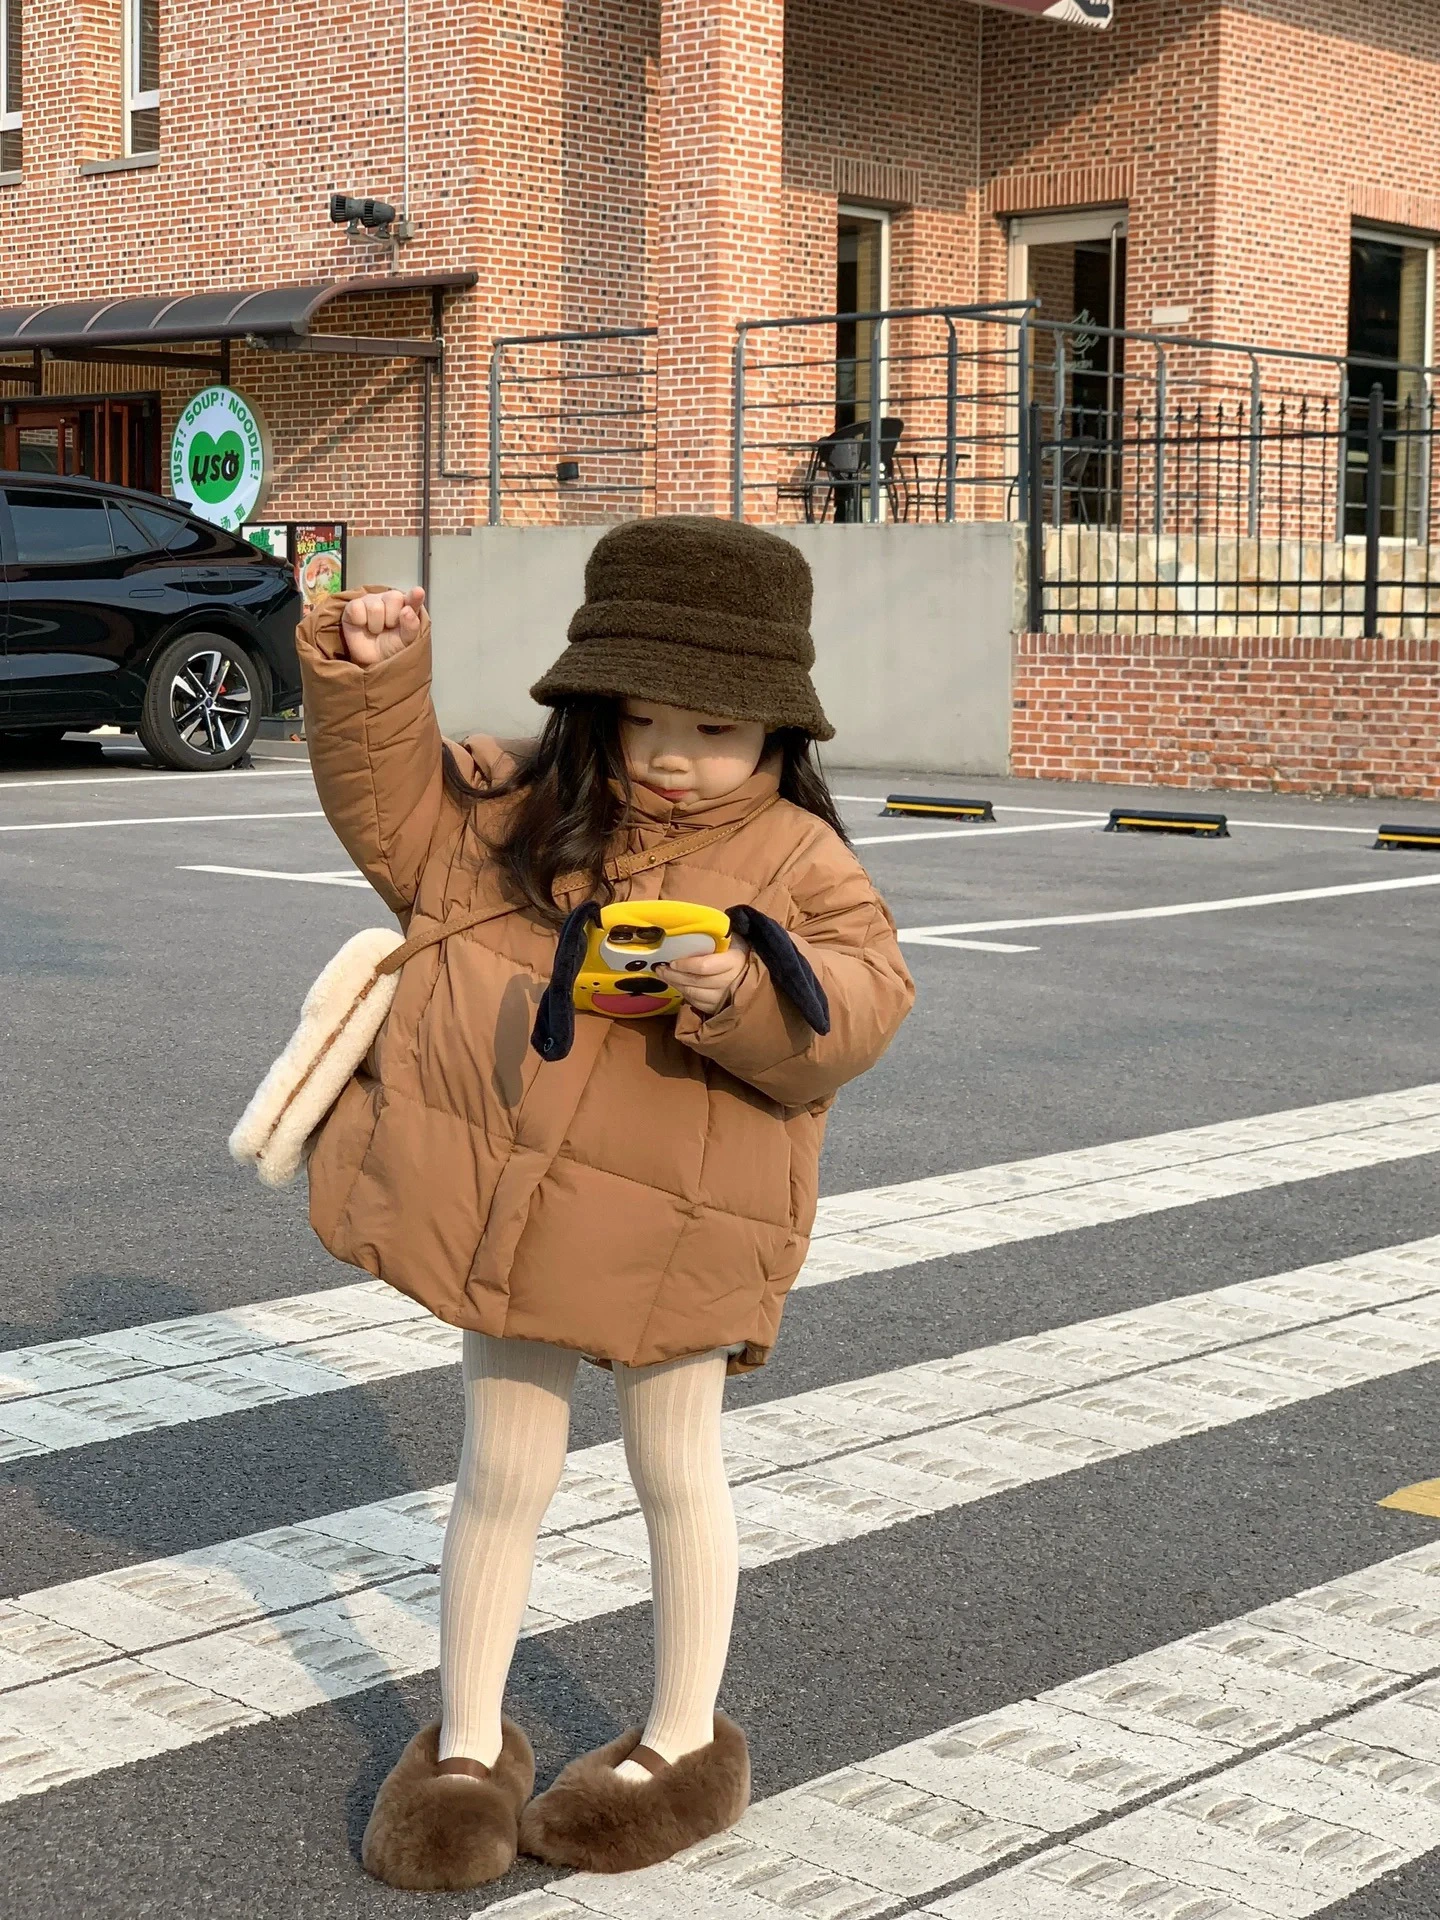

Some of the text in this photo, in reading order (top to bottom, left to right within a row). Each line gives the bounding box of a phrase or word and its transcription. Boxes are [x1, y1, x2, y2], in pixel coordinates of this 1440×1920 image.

[173, 391, 260, 485] JUST! SOUP! NOODLE!
[208, 503, 246, 530] 汤面
